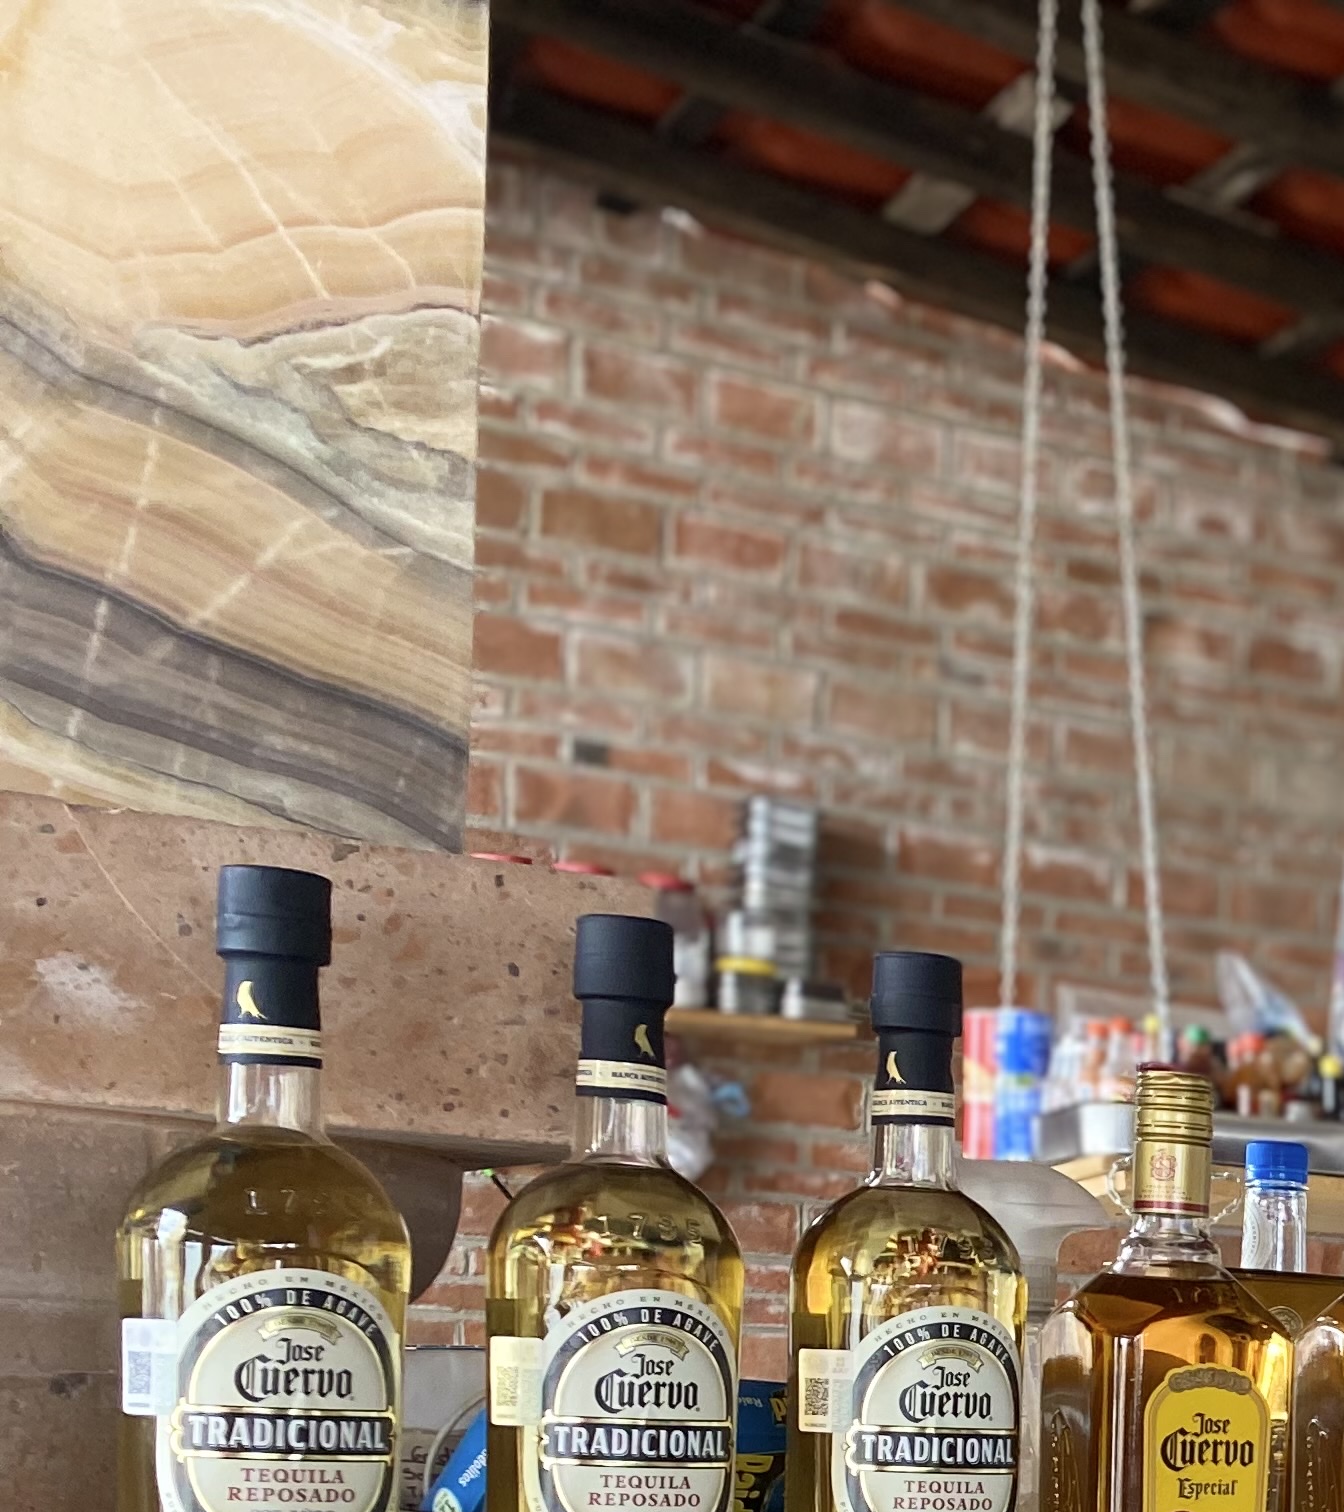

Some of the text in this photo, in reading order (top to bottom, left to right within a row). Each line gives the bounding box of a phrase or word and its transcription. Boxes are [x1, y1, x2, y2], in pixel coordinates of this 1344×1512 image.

[213, 1288, 380, 1337] 100% DE AGAVE
[576, 1309, 717, 1352] 100% DE AGAVE
[883, 1324, 1010, 1365] 100% DE AGAVE
[234, 1353, 353, 1403] Cuervo
[631, 1353, 675, 1379] Jose
[932, 1365, 971, 1391] Jose
[594, 1368, 699, 1414] Cuervo
[898, 1379, 992, 1424] Cuervo
[188, 1414, 386, 1451] TRADICIONAL
[1191, 1411, 1232, 1438] Jose
[554, 1426, 726, 1457] TRADICIONAL
[862, 1434, 1014, 1466] TRADICIONAL
[1160, 1427, 1255, 1472] Cuervo
[240, 1467, 346, 1485] TEQUILA
[600, 1474, 691, 1490] TEQUILA
[903, 1480, 985, 1495] TEQUILA
[1177, 1476, 1238, 1502] Especial
[227, 1486, 356, 1504] REPOSADO
[587, 1492, 701, 1507] REPOSADO
[893, 1496, 993, 1511] REPOSADO
